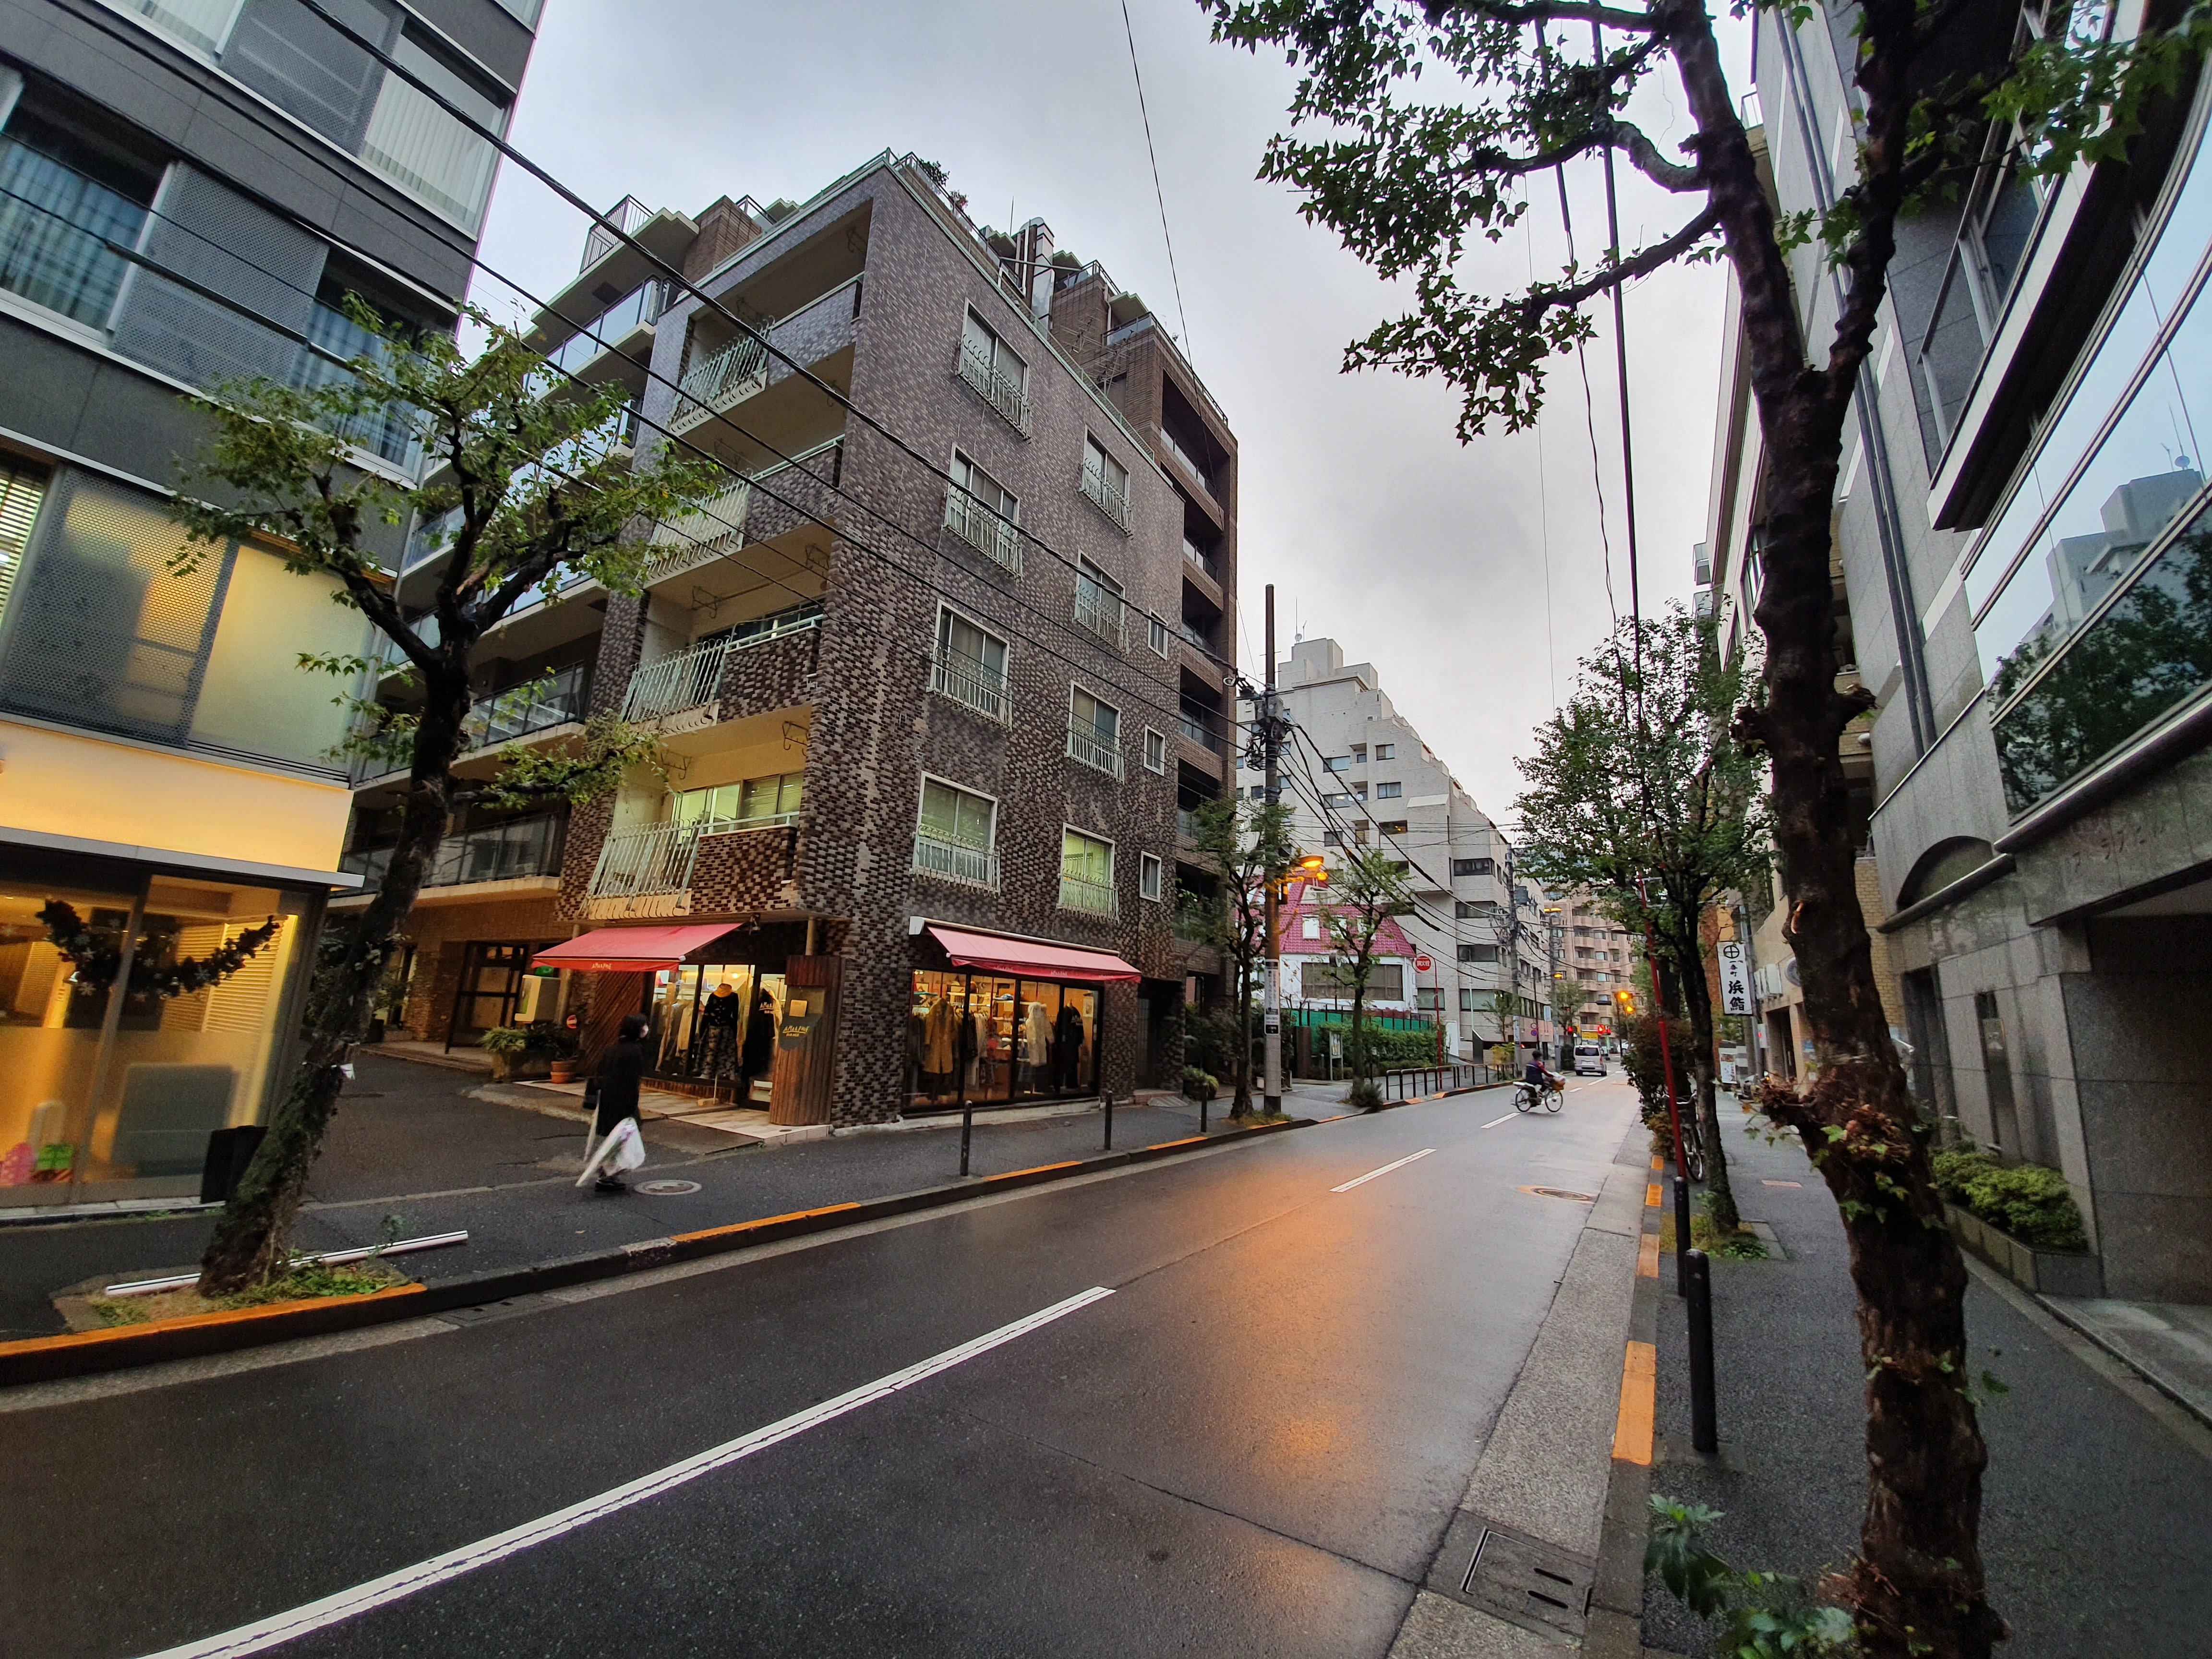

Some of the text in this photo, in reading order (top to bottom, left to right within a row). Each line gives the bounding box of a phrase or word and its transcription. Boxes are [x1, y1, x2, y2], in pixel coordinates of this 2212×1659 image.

[1728, 961, 1744, 1011] 一番町 浜鮨
